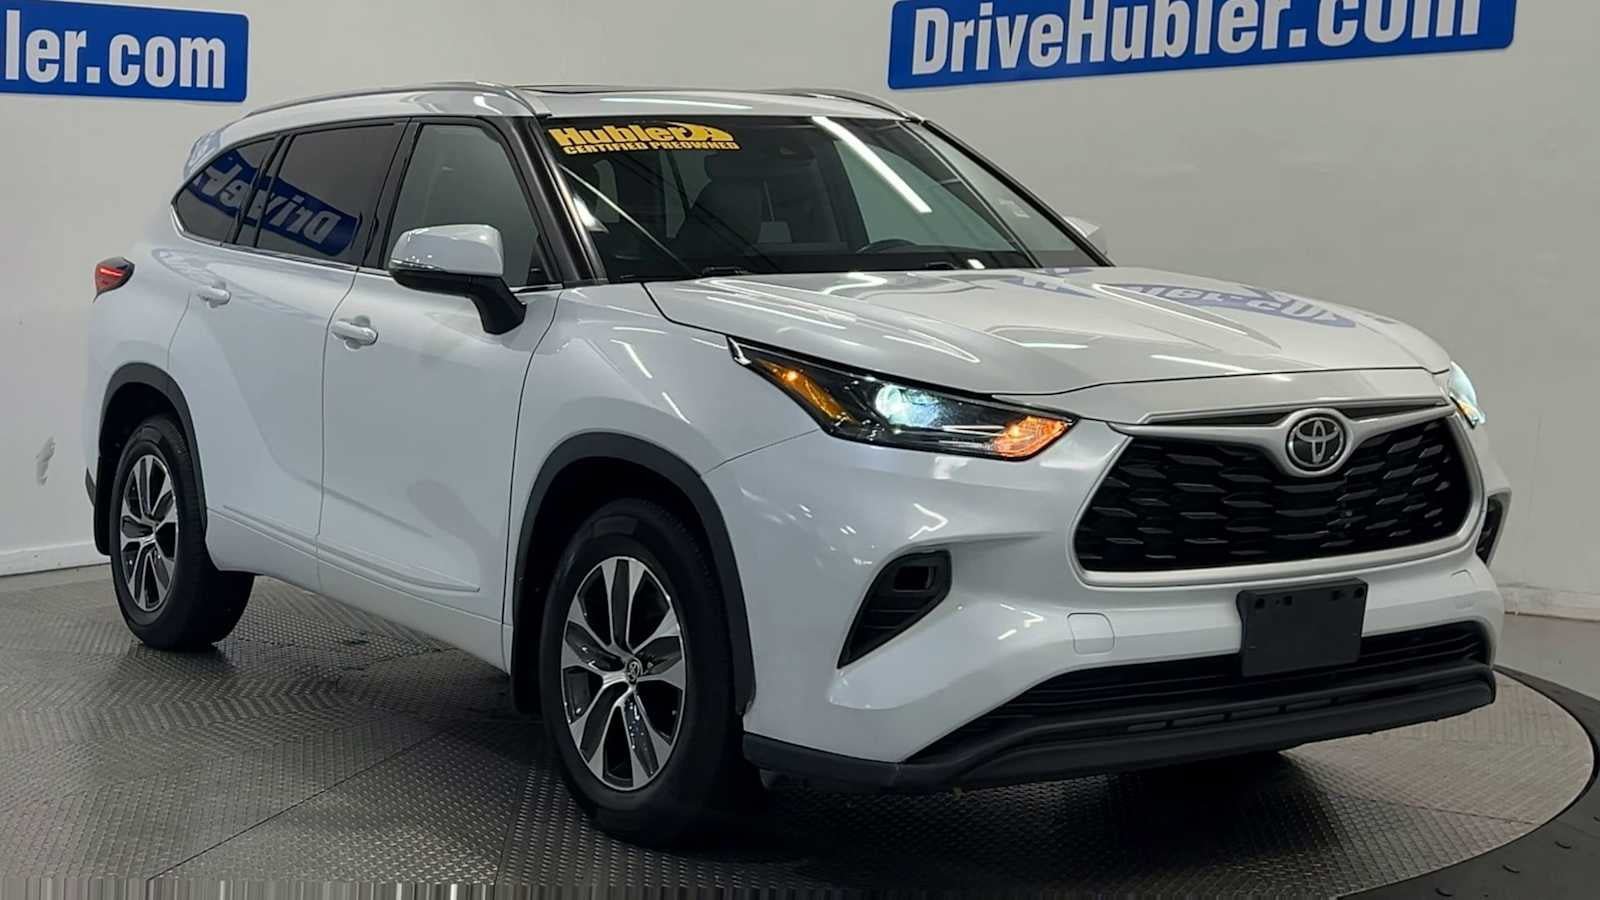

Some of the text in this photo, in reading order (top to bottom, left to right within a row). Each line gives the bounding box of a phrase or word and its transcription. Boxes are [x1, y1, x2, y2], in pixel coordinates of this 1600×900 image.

[5, 9, 226, 89] ler.com
[549, 125, 688, 146] Hubler
[563, 141, 740, 155] CERTIFIED PREOWNED
